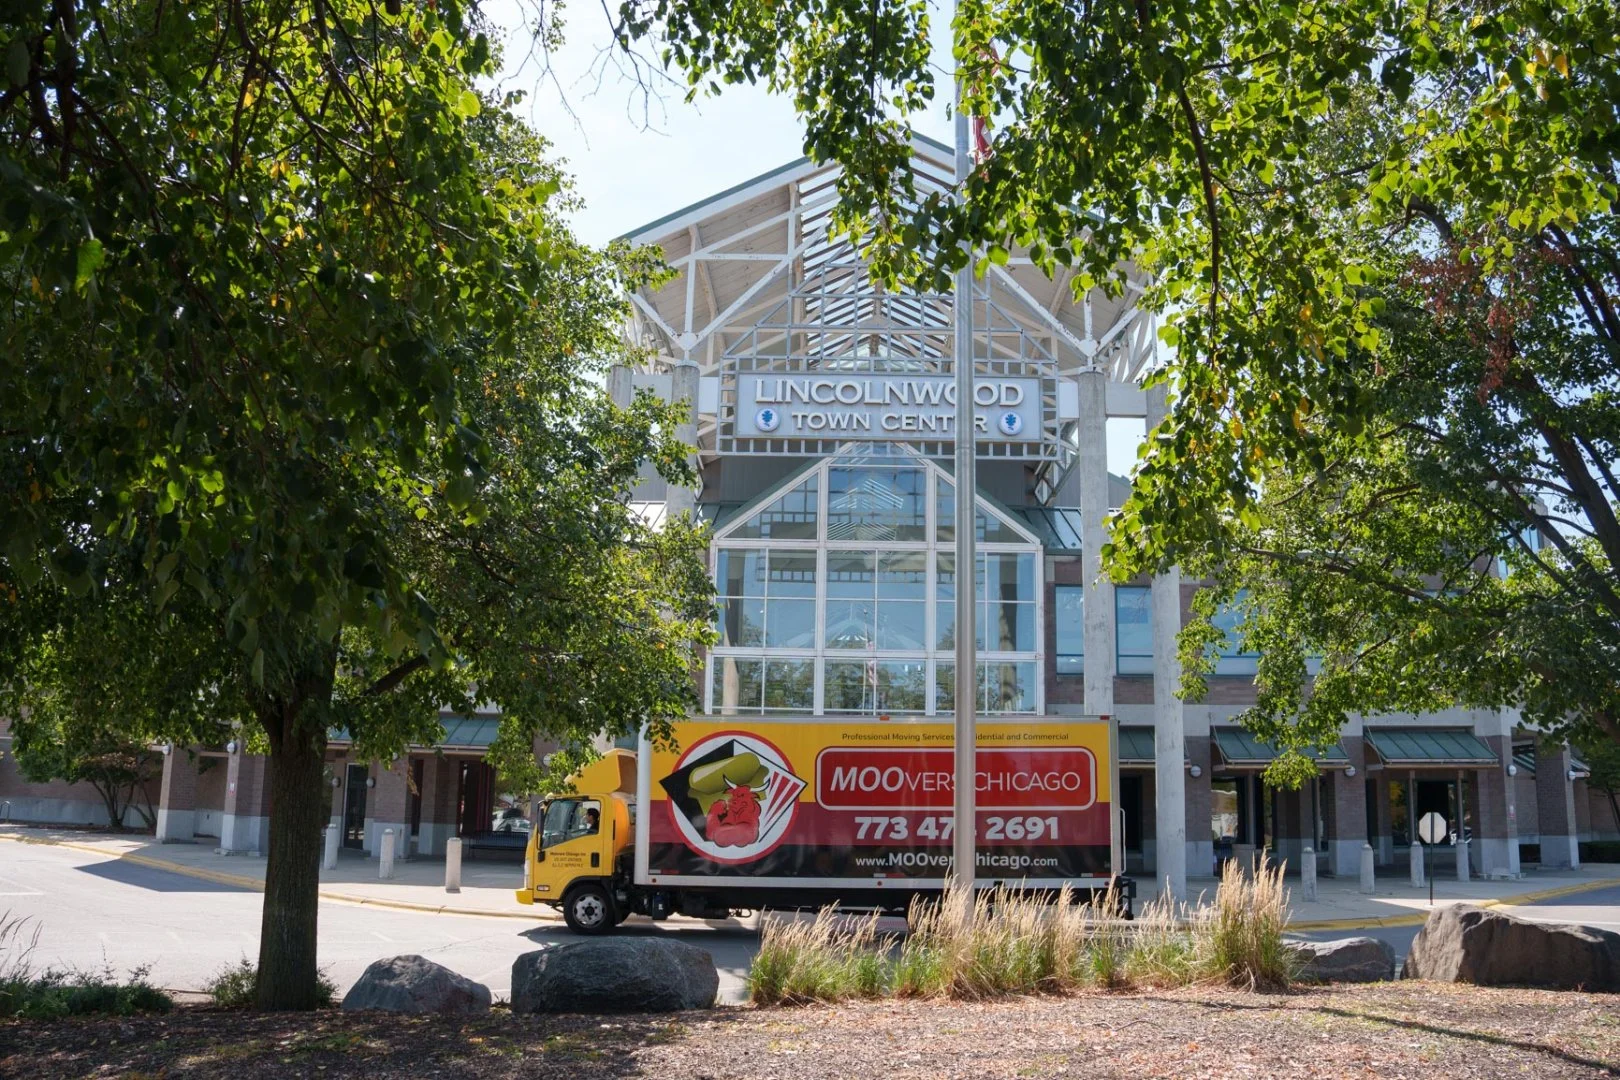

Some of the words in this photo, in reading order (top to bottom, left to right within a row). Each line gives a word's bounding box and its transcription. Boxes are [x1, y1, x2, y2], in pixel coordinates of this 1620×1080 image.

[791, 411, 871, 430] TOWN
[881, 412, 988, 432] CENTR
[842, 733, 890, 741] Professional
[892, 733, 920, 742] Moving
[922, 733, 955, 741] Services
[975, 733, 1005, 741] idential
[1006, 733, 1021, 741] and
[1023, 733, 1069, 741] Commercial
[854, 816, 909, 840] 773
[916, 816, 977, 840] 47
[985, 816, 1059, 840] 2691
[855, 852, 1058, 870] www.MOOverhicago.com
